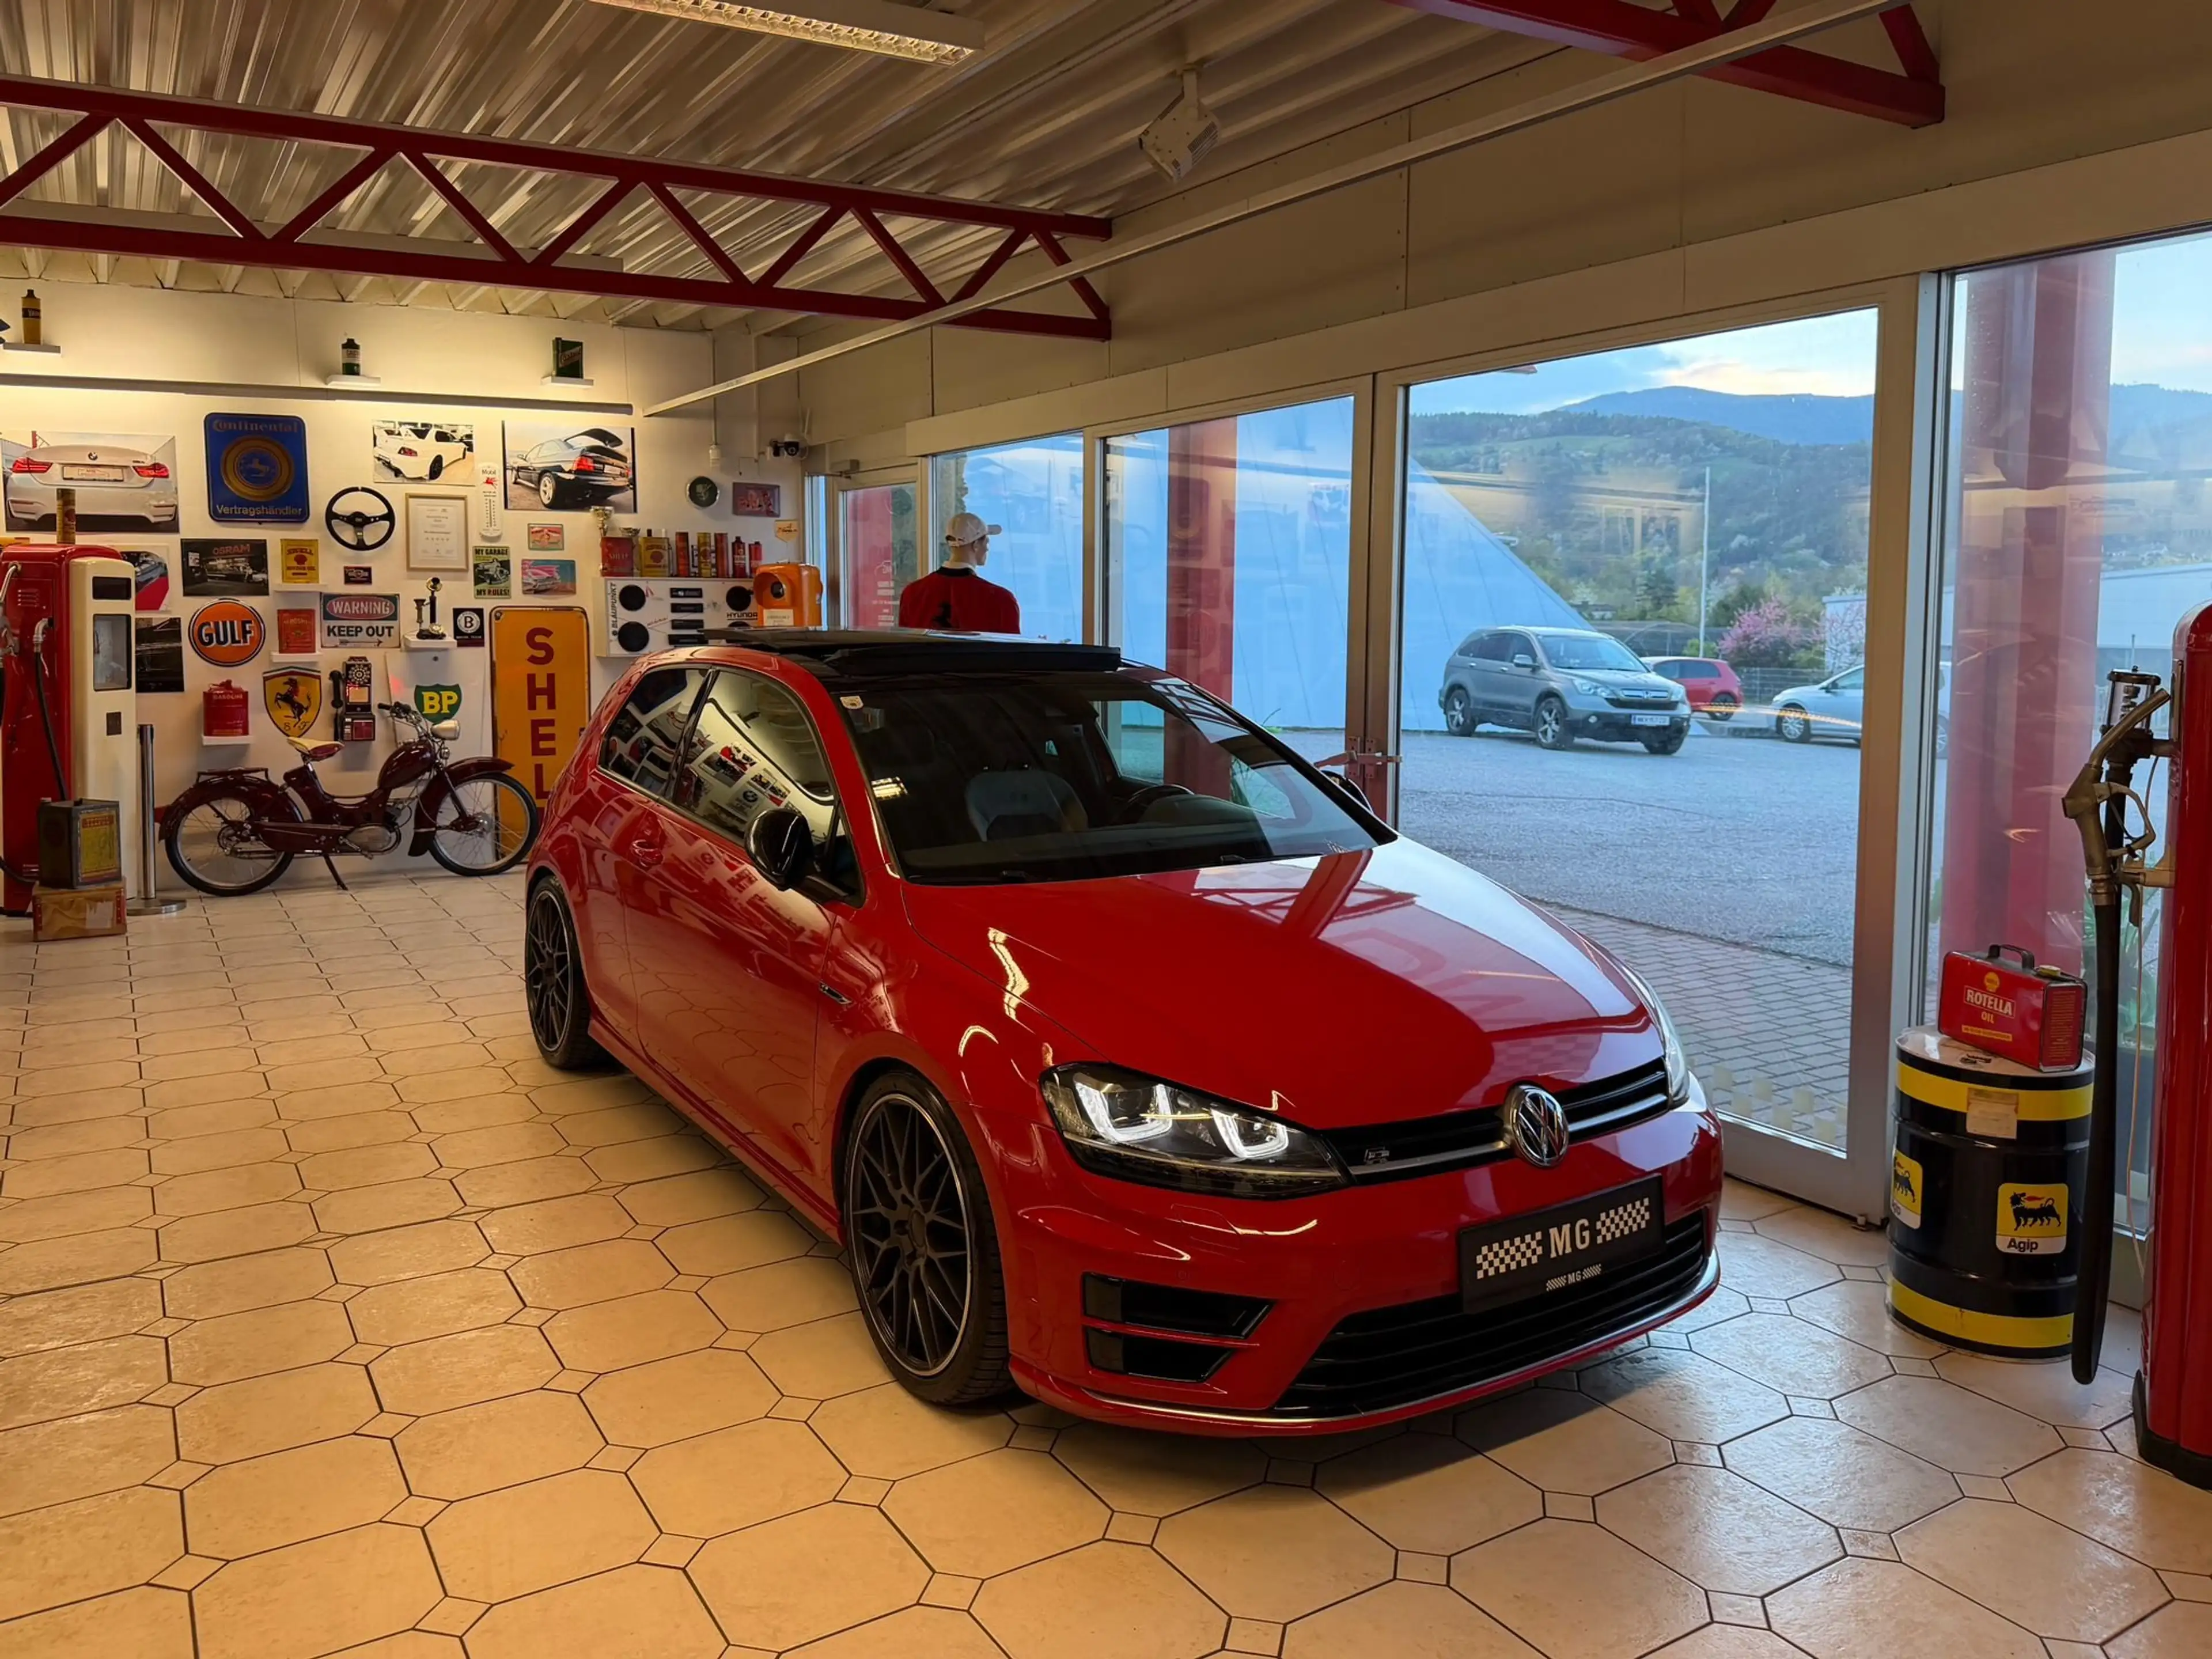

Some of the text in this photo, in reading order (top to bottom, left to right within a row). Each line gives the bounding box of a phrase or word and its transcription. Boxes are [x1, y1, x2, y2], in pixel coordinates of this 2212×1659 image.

[213, 419, 299, 432] Continental
[216, 505, 302, 516] Vertragshändler
[213, 544, 250, 556] OSRAM
[332, 601, 390, 615] WARNING
[198, 619, 254, 647] GULF
[327, 625, 394, 637] KEEP OUT
[422, 691, 459, 714] BP
[525, 627, 556, 828] SHEL
[1966, 988, 2013, 1016] ROTELLA
[1980, 1011, 1995, 1024] OIL
[1549, 1218, 1590, 1259] MG
[2007, 1238, 2039, 1252] Agip
[1567, 1271, 1582, 1285] MG
